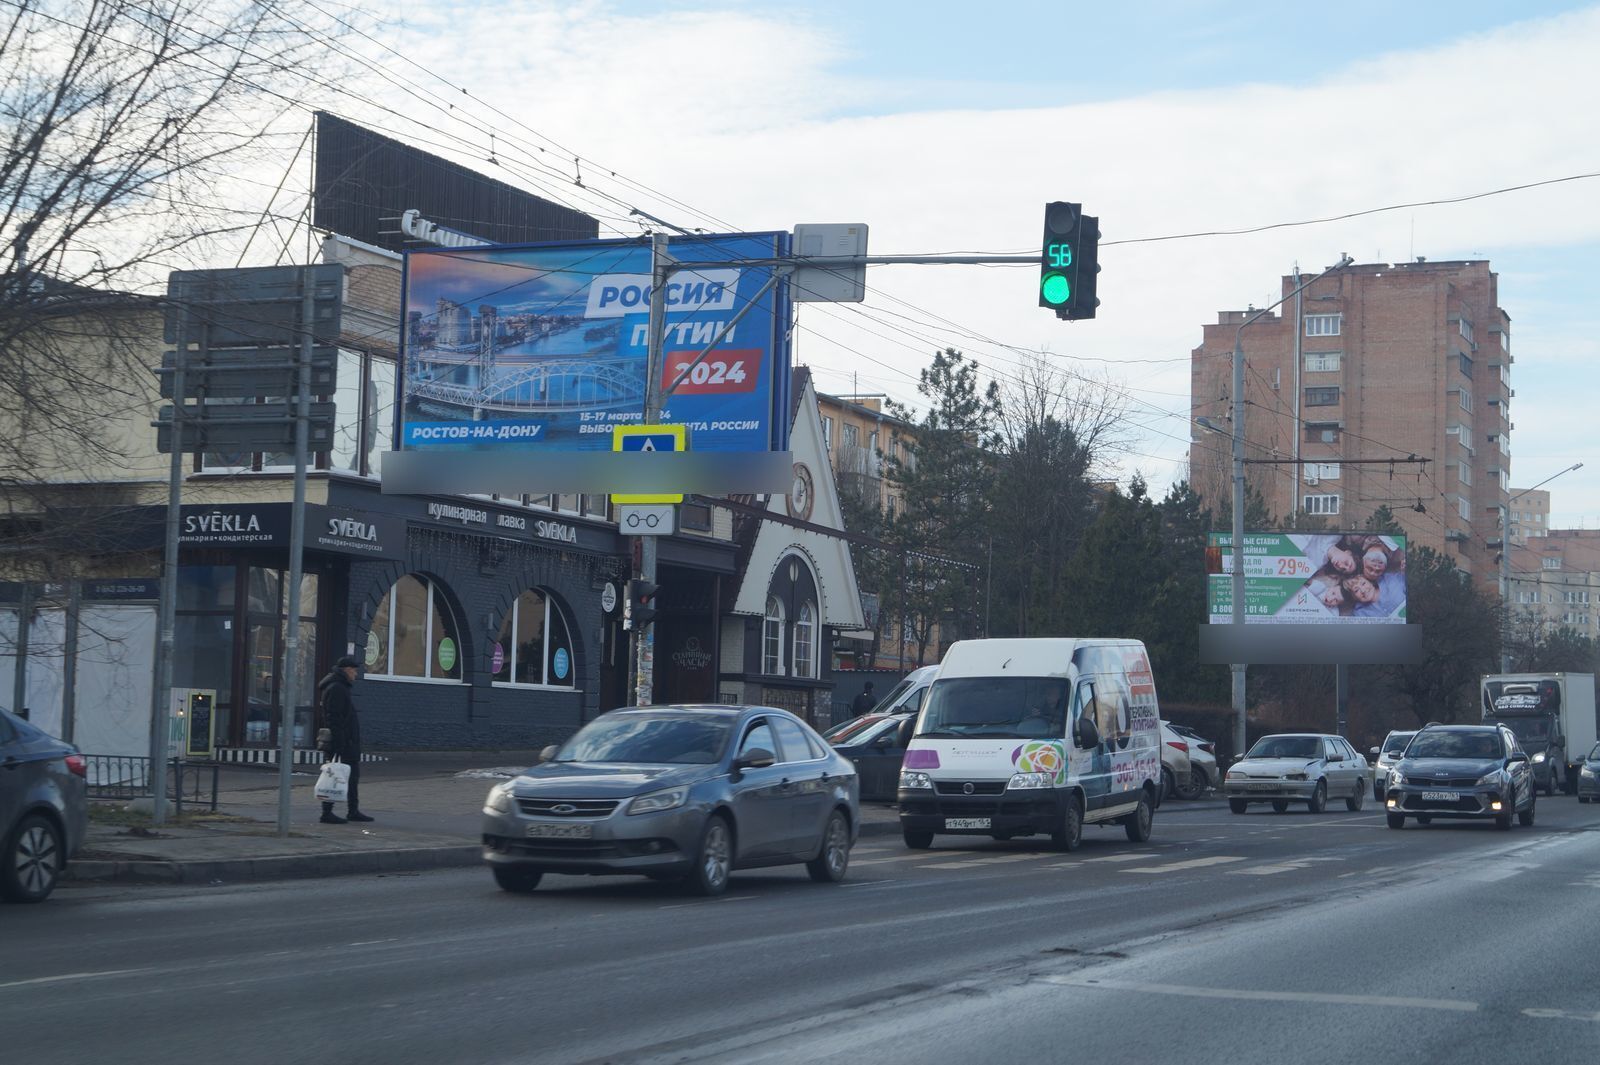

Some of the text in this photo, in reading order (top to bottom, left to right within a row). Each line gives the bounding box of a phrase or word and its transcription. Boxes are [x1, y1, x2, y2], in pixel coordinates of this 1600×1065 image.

[673, 360, 746, 385] 2024
[607, 413, 642, 422] марта
[412, 425, 541, 439] РОСТОВ-НА-ДОНУ
[579, 424, 624, 433] ВЫБО
[711, 421, 759, 430] РОССИИ
[496, 514, 525, 530] лавка
[1256, 537, 1280, 545] СТАВКИ
[1278, 558, 1310, 575] 29%
